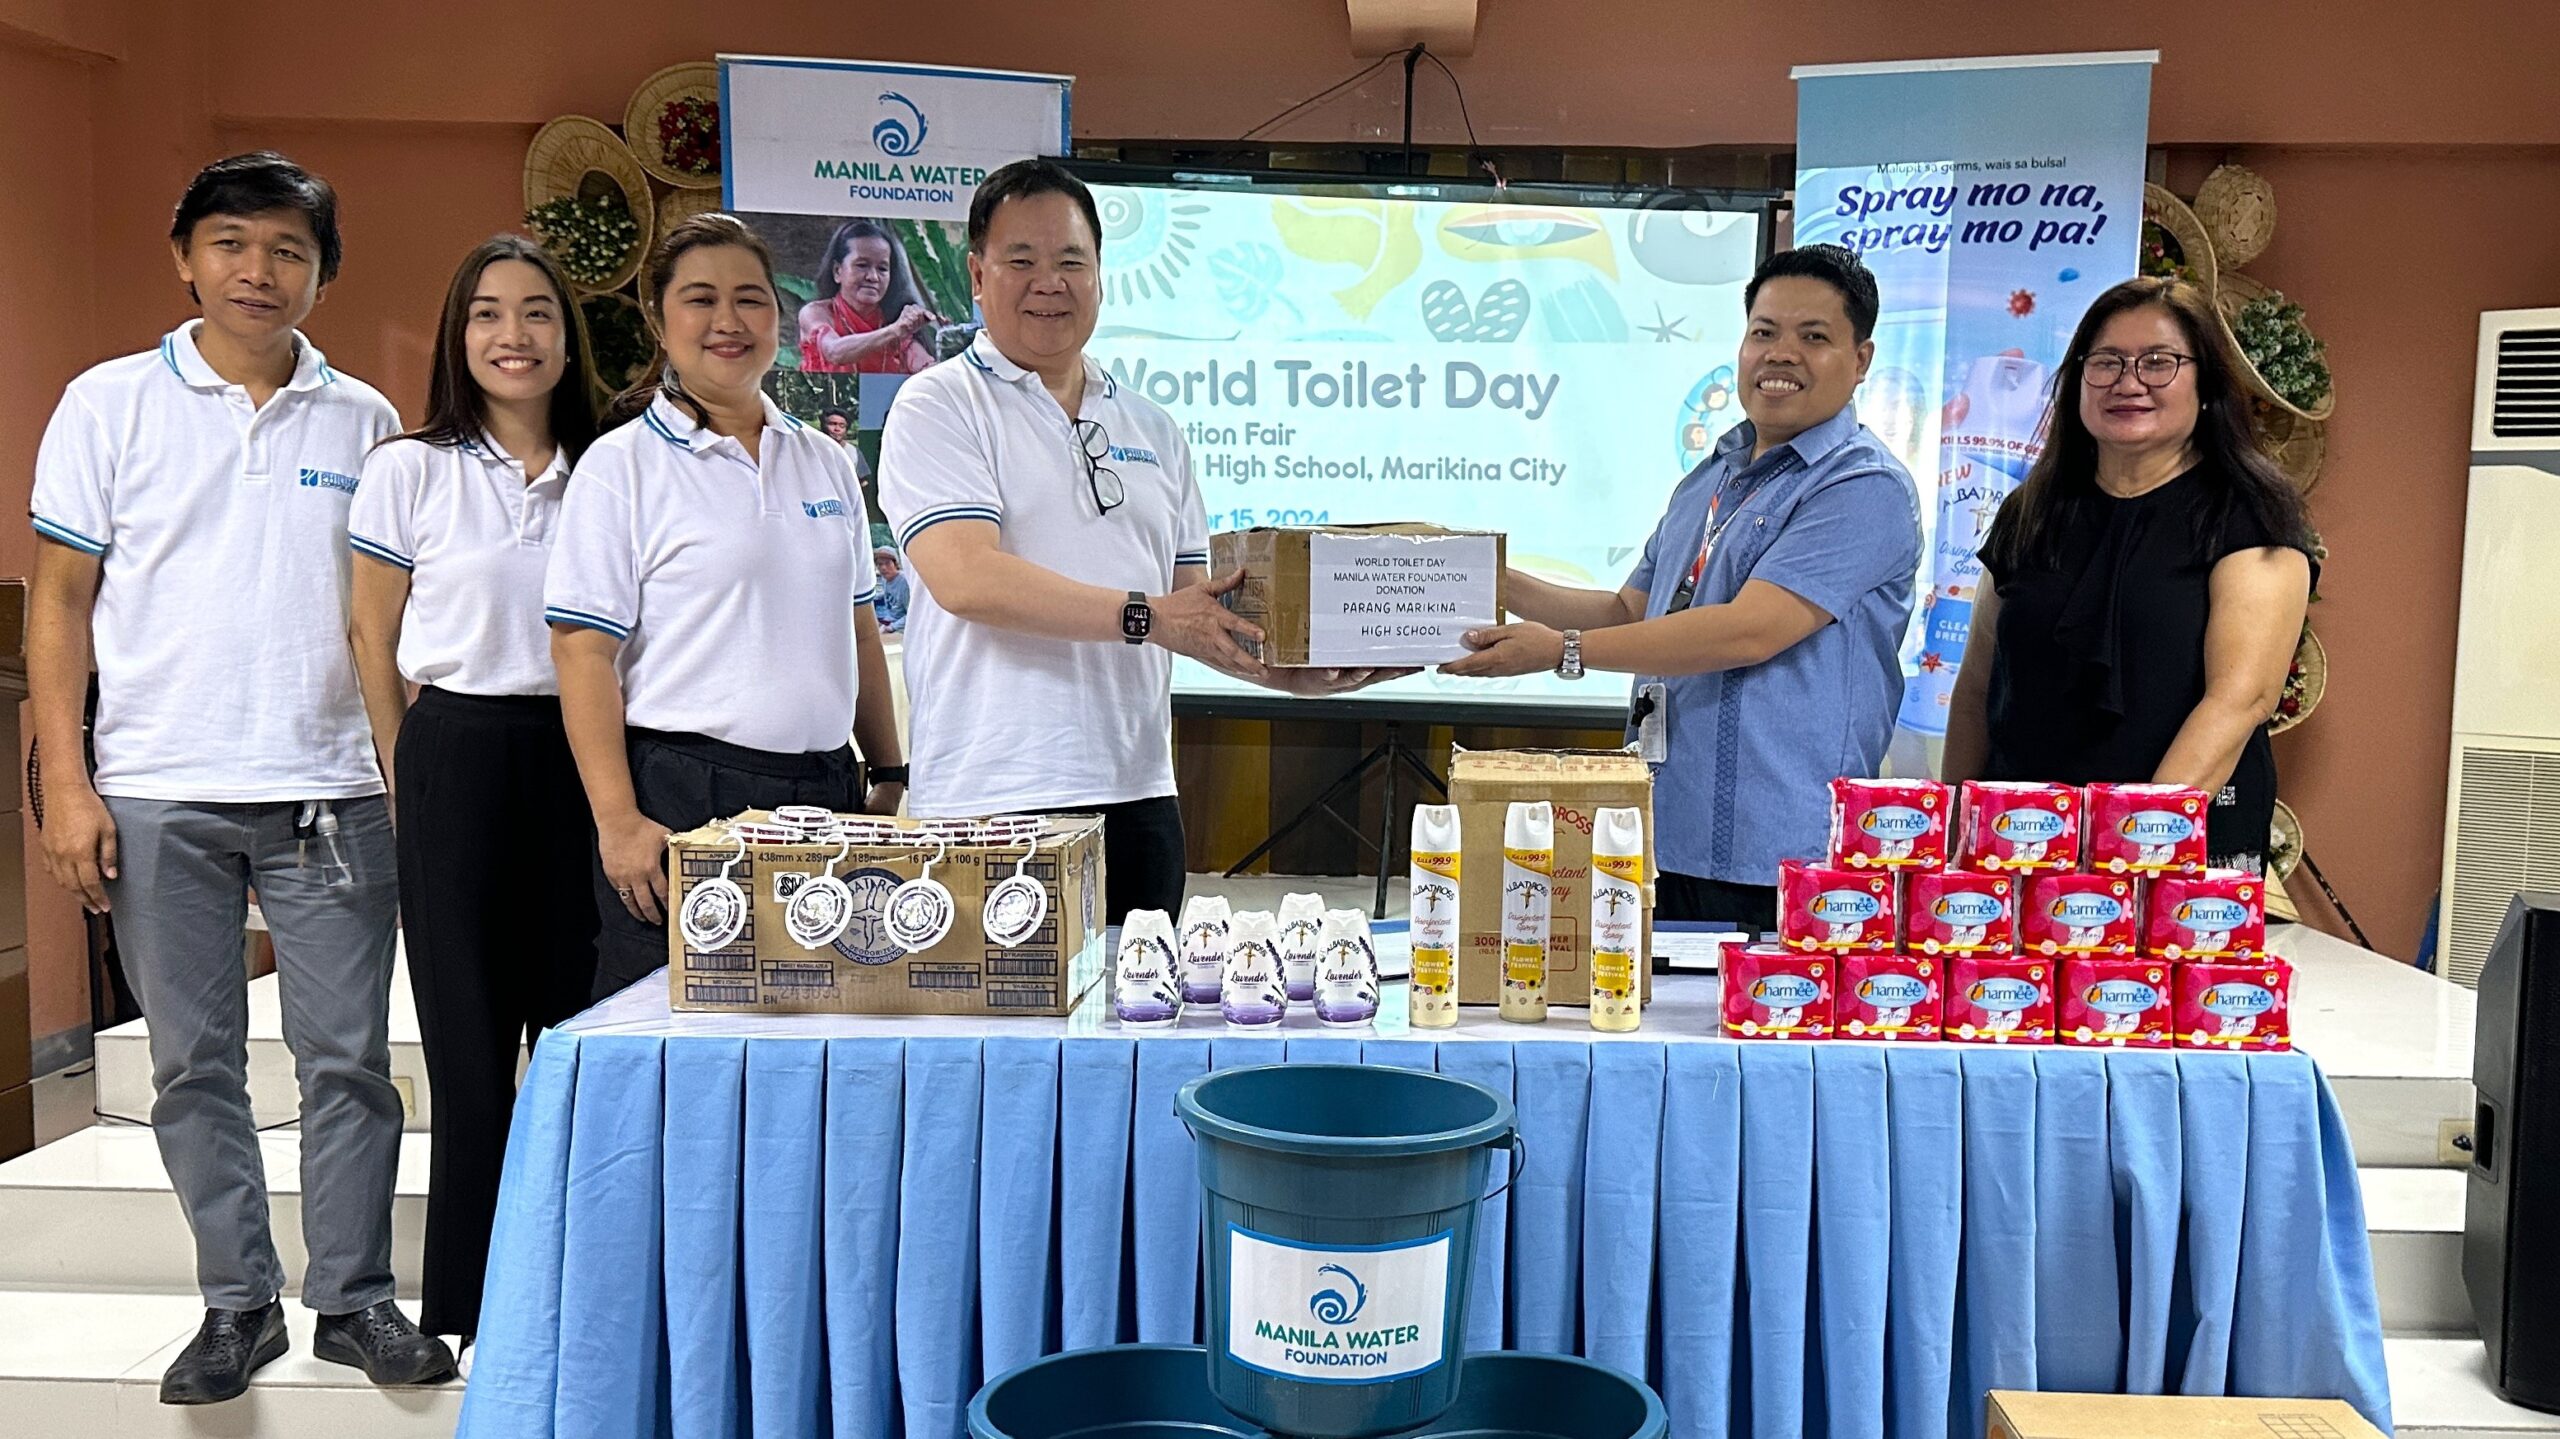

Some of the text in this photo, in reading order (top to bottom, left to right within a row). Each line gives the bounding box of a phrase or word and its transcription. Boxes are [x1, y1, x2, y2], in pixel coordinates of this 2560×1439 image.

[814, 159, 987, 187] MANILA WATER
[1941, 159, 1982, 175] germs,
[1985, 160, 2012, 171] wais
[2014, 160, 2028, 169] sa
[2031, 156, 2067, 169] bulsa!
[849, 185, 954, 203] FOUNDATION
[1835, 182, 2104, 222] Spray mo na,
[1839, 214, 2107, 257] spray mo pa!
[1094, 357, 1560, 420] World Toilet Day
[1184, 422, 1296, 447] tion Fair
[1206, 453, 1567, 486] High School, Marikina City
[1266, 509, 1329, 526] 2024
[1354, 557, 1446, 567] WORLD TOILET DAY
[1333, 572, 1468, 583] MANILA WATER FOUNDATION
[1376, 585, 1425, 595] DONATION
[1343, 602, 1456, 614] PARANG MARIKINA
[1361, 625, 1442, 636] HIGH SCHOOL
[1938, 619, 1969, 632] CLEA
[758, 852, 794, 863] 438mm
[908, 854, 919, 864] 16
[955, 854, 971, 864] 100
[763, 994, 778, 1005] BN
[1254, 1319, 1420, 1349] MANILA WATER
[1285, 1349, 1388, 1367] FOUNDATION
